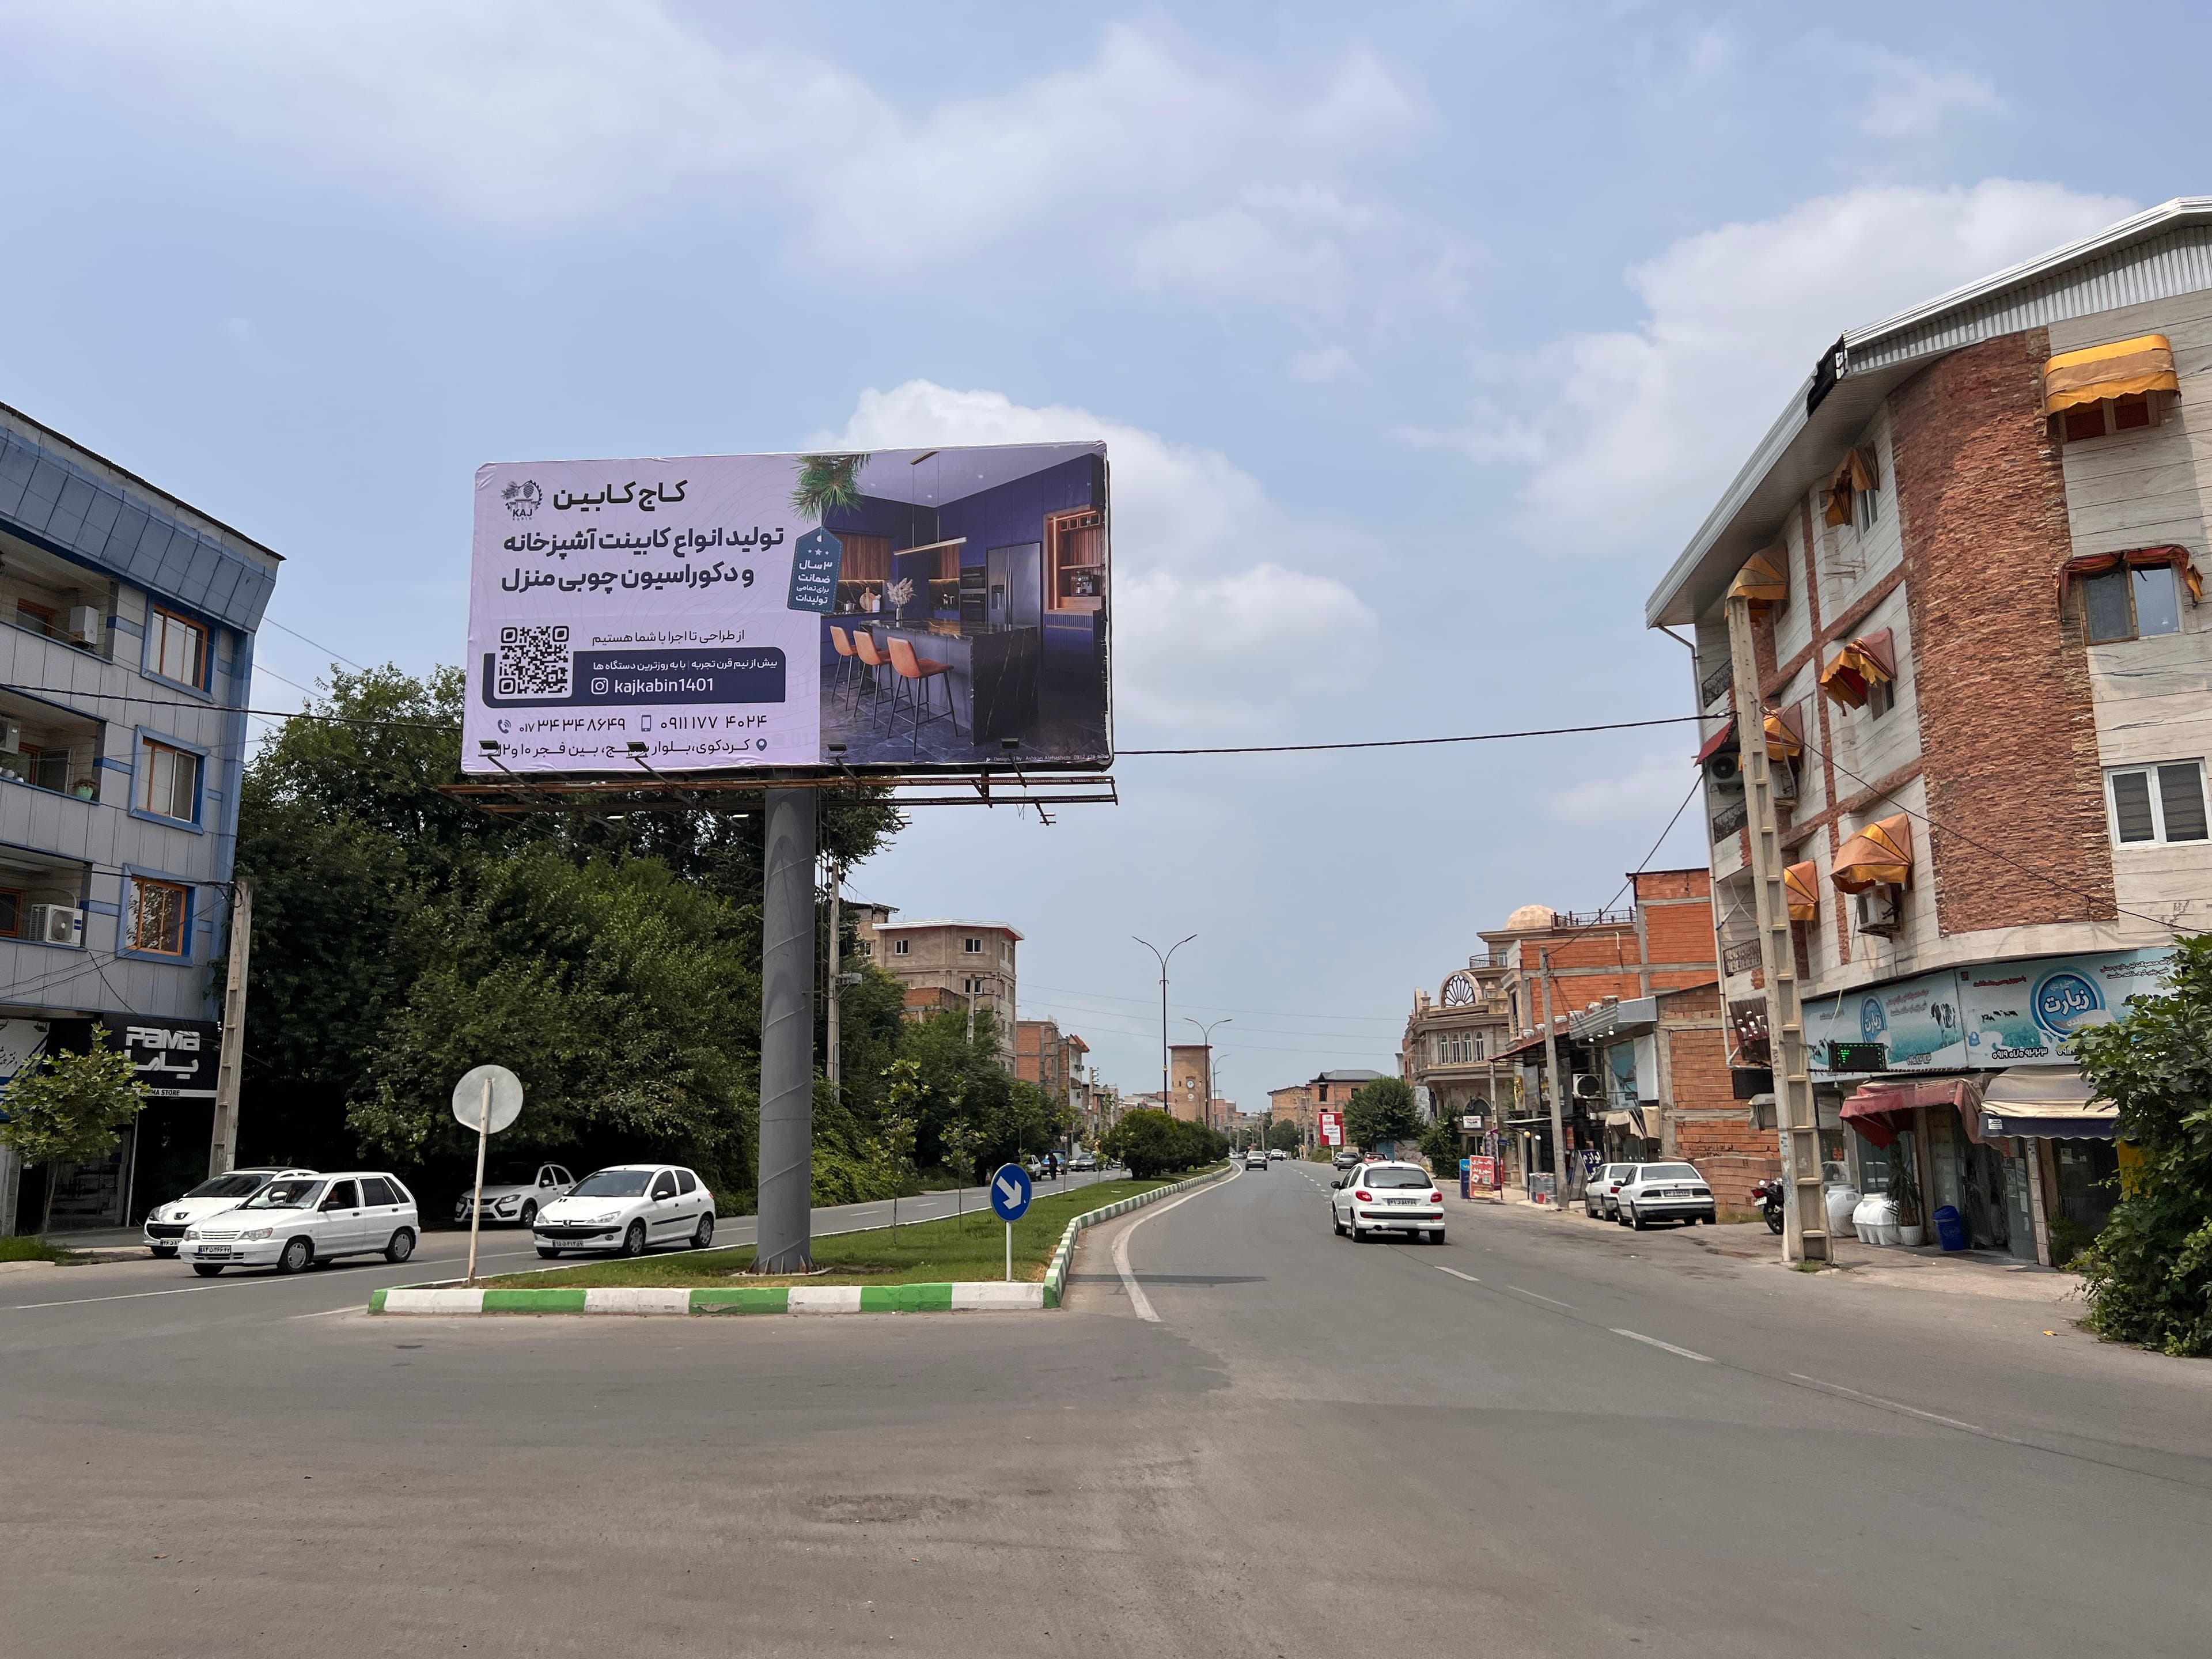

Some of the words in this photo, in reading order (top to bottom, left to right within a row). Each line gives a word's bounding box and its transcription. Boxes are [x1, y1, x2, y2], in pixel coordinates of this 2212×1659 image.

[554, 480, 637, 512] کابین
[638, 479, 688, 512] کاج
[513, 509, 532, 517] KAJ
[504, 528, 597, 560] آشپزخانه
[599, 527, 672, 555] کابینت
[673, 527, 722, 558] انواع
[726, 526, 783, 552] تولید
[799, 559, 823, 570] سال
[502, 568, 555, 593] منزل
[621, 560, 738, 590] دکوراسیون
[742, 569, 754, 588] و
[798, 573, 831, 584] ضمانت
[558, 571, 618, 594] چوبی
[816, 586, 830, 594] برای
[796, 594, 828, 605] تولیدات
[592, 634, 632, 646] هستیم
[635, 631, 656, 642] شما
[658, 631, 666, 644] با
[668, 631, 687, 644] اجرا
[689, 631, 697, 641] تا
[699, 630, 735, 643] طراحی
[736, 630, 744, 643] از
[593, 662, 604, 670] ها
[605, 660, 636, 670] دستگاه
[637, 661, 668, 672] روزترین
[669, 661, 677, 671] به
[679, 660, 686, 670] با
[691, 660, 715, 670] تجربه
[717, 658, 733, 669] قرن
[733, 660, 749, 670] نیم
[749, 658, 756, 669] از
[757, 658, 778, 669] بیش
[614, 678, 713, 696] kajkabin1401
[533, 742, 566, 758] فجر
[569, 746, 599, 757] بین
[651, 741, 691, 756] بلوار
[2044, 988, 2090, 1016] زیارت
[1582, 1151, 1601, 1164] لوازم
